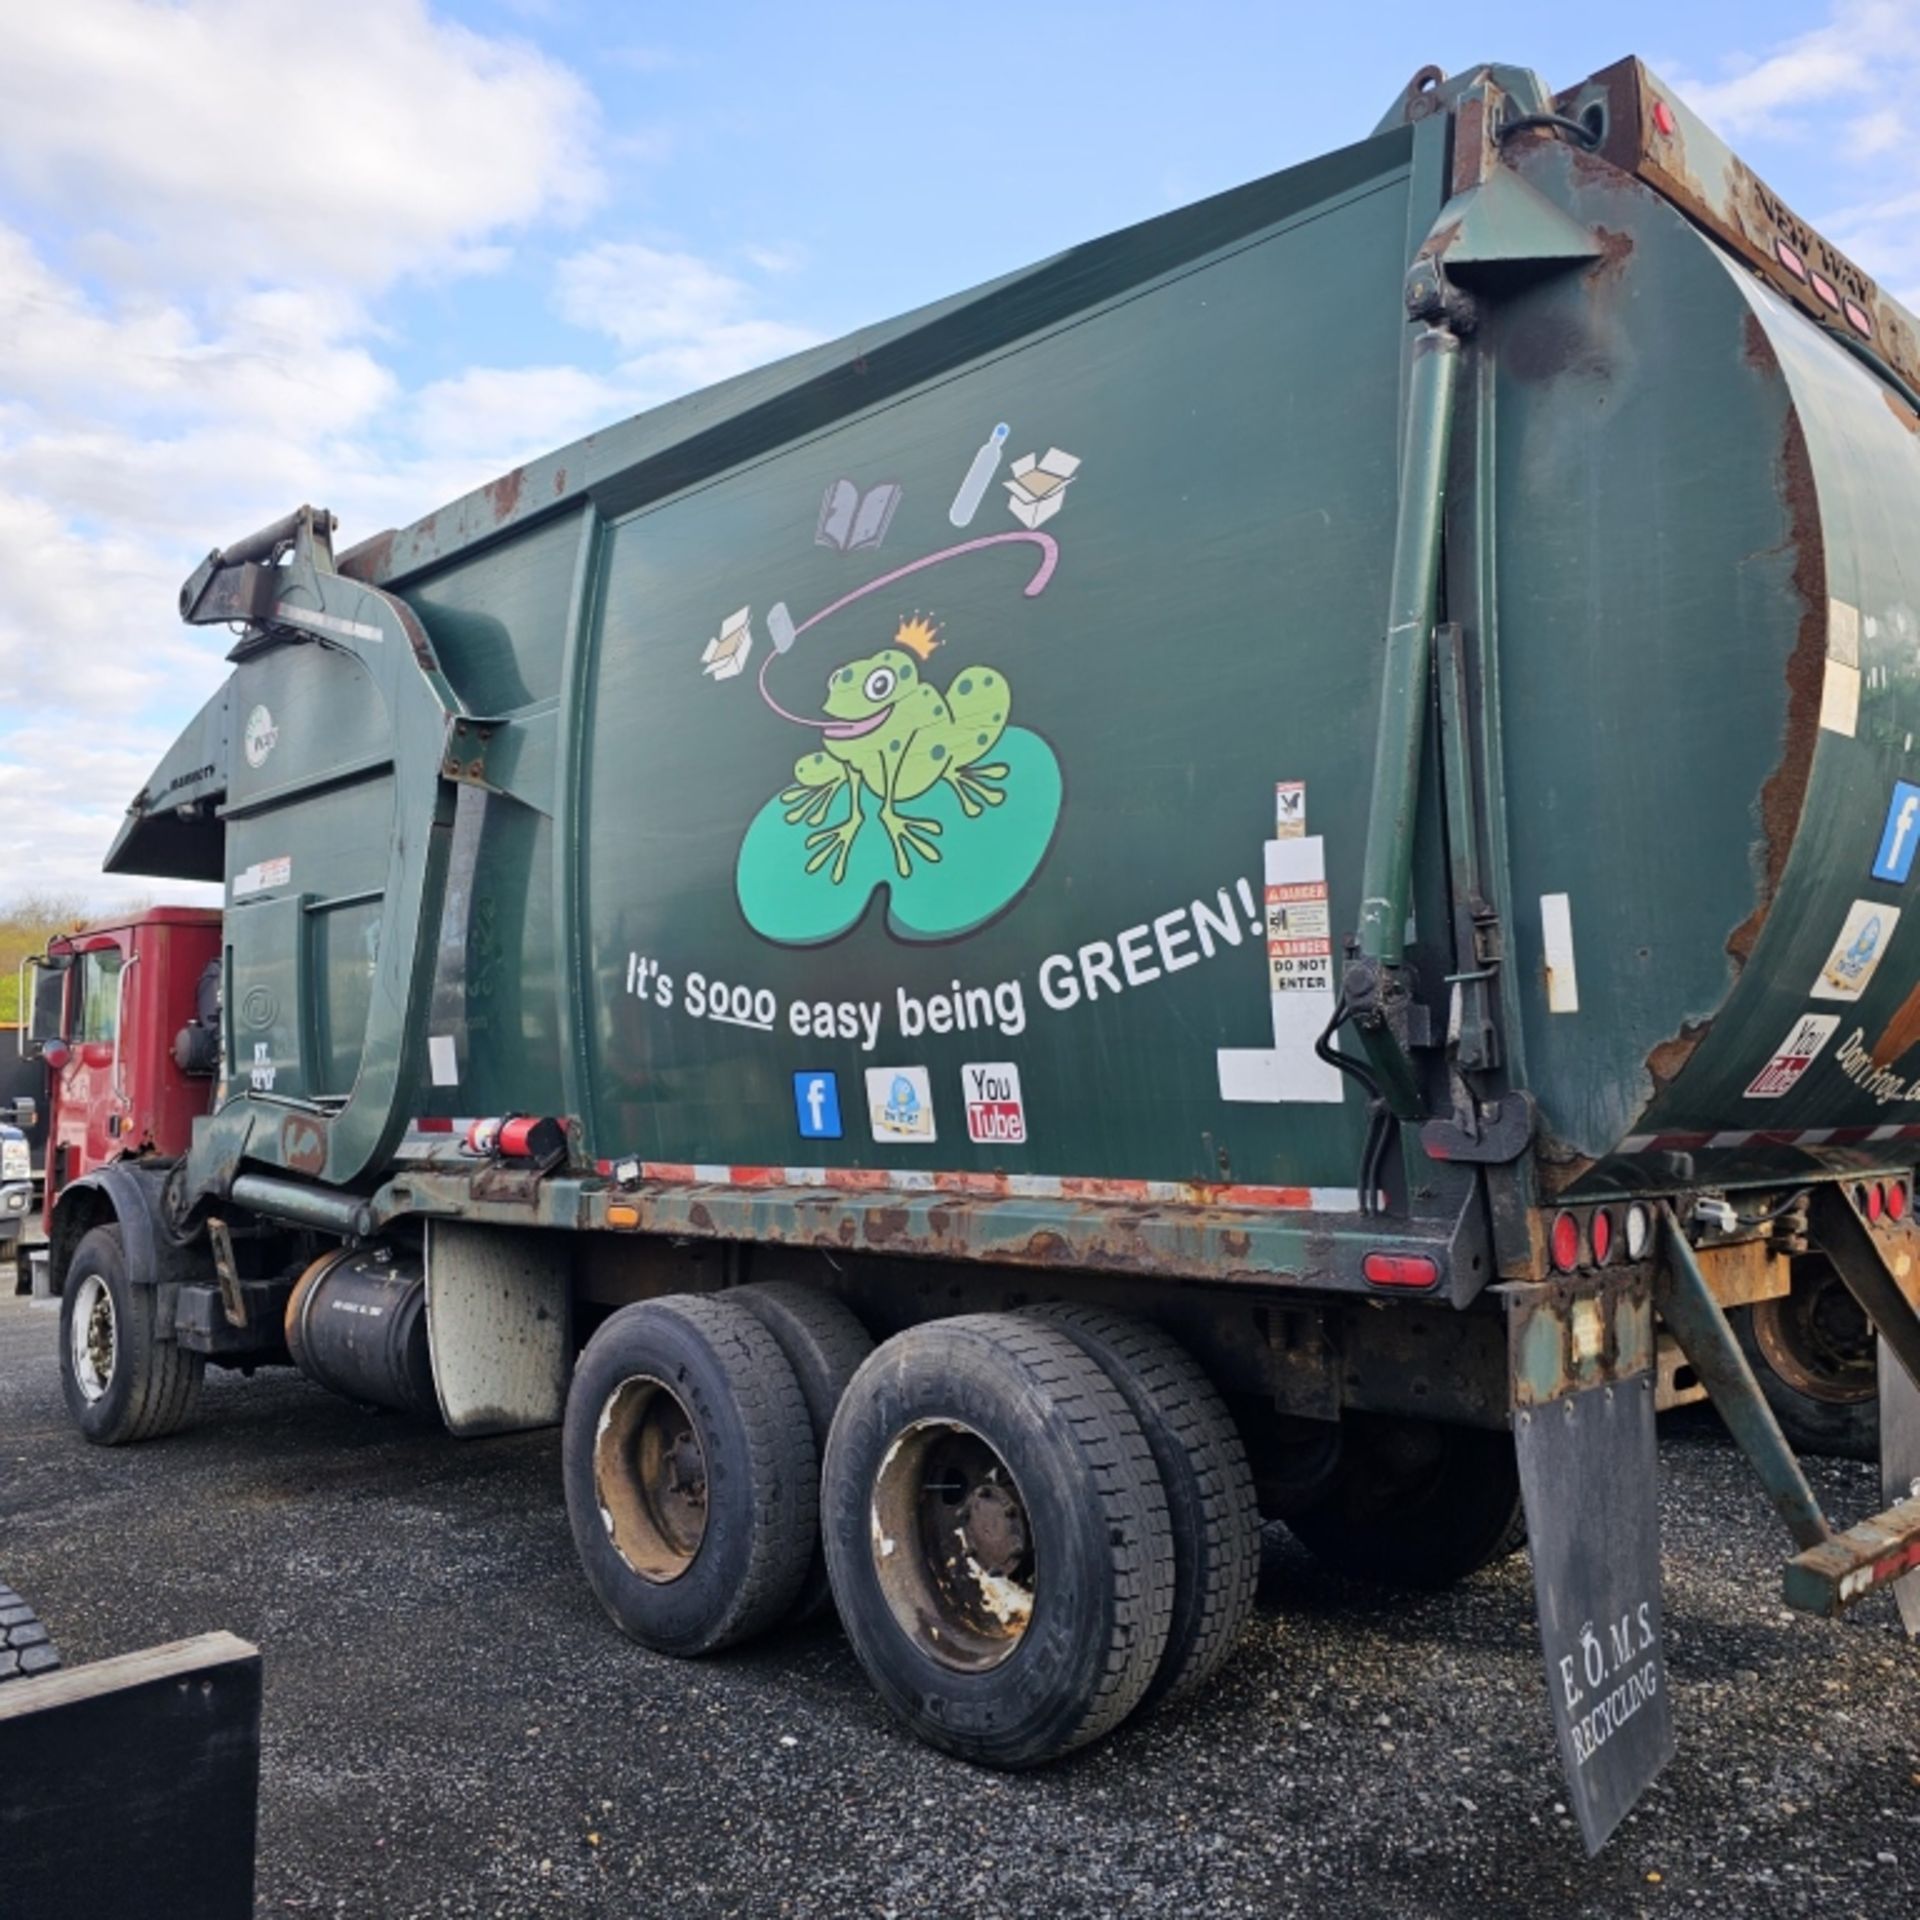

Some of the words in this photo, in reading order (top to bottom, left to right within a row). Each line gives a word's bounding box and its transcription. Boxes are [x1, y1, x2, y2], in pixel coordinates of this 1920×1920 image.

[626, 951, 673, 1008] It's
[684, 972, 776, 1030] Sooo
[789, 1000, 881, 1051] easy
[896, 979, 1026, 1036] being
[1039, 877, 1264, 1010] GREEN!
[1275, 960, 1293, 972] DO
[1299, 959, 1327, 970] NOT
[1279, 977, 1326, 989] ENTER
[1788, 1020, 1826, 1056] You
[971, 1069, 1011, 1100] You
[970, 1105, 1022, 1138] Tube
[1570, 1661, 1656, 1767] RECYCLING
